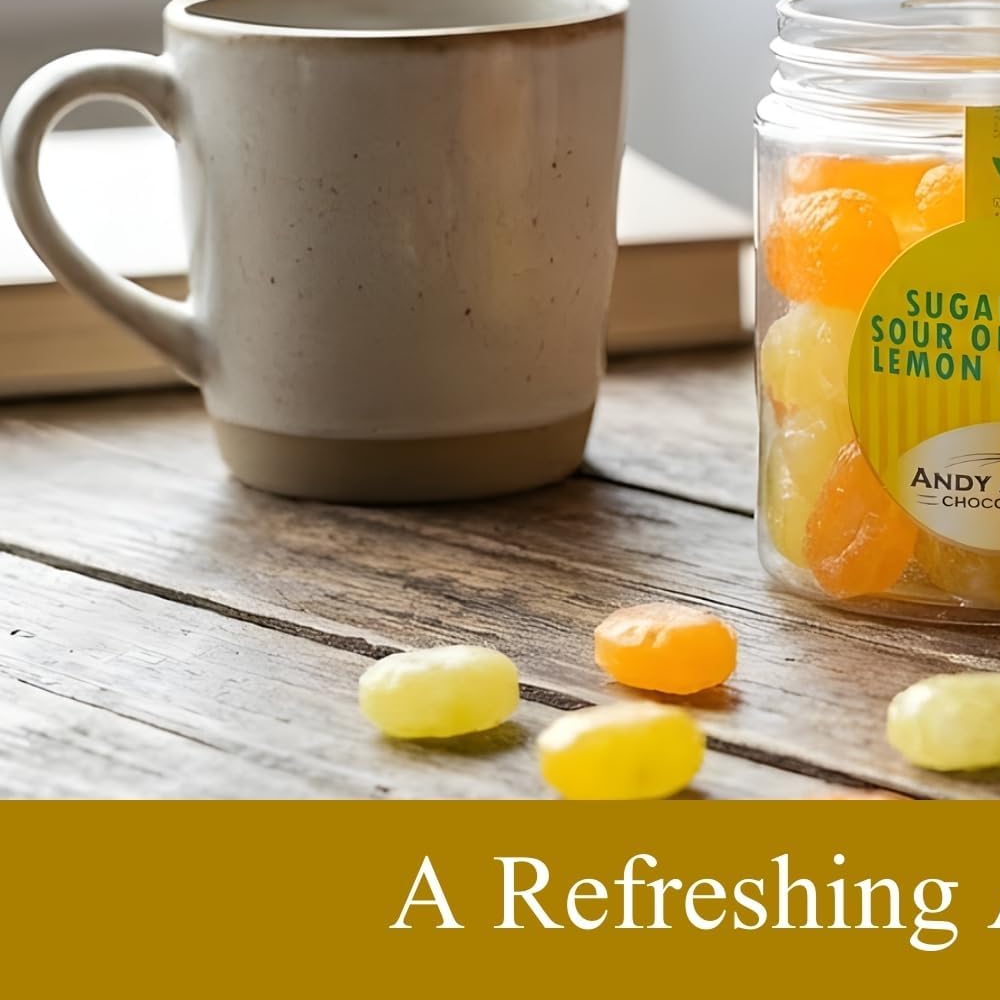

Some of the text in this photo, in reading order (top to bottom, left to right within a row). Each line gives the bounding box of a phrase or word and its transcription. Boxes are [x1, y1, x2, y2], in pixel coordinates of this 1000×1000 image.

[871, 314, 953, 350] SOUR
[873, 345, 982, 382] LEMON
[910, 467, 992, 493] ANDY
